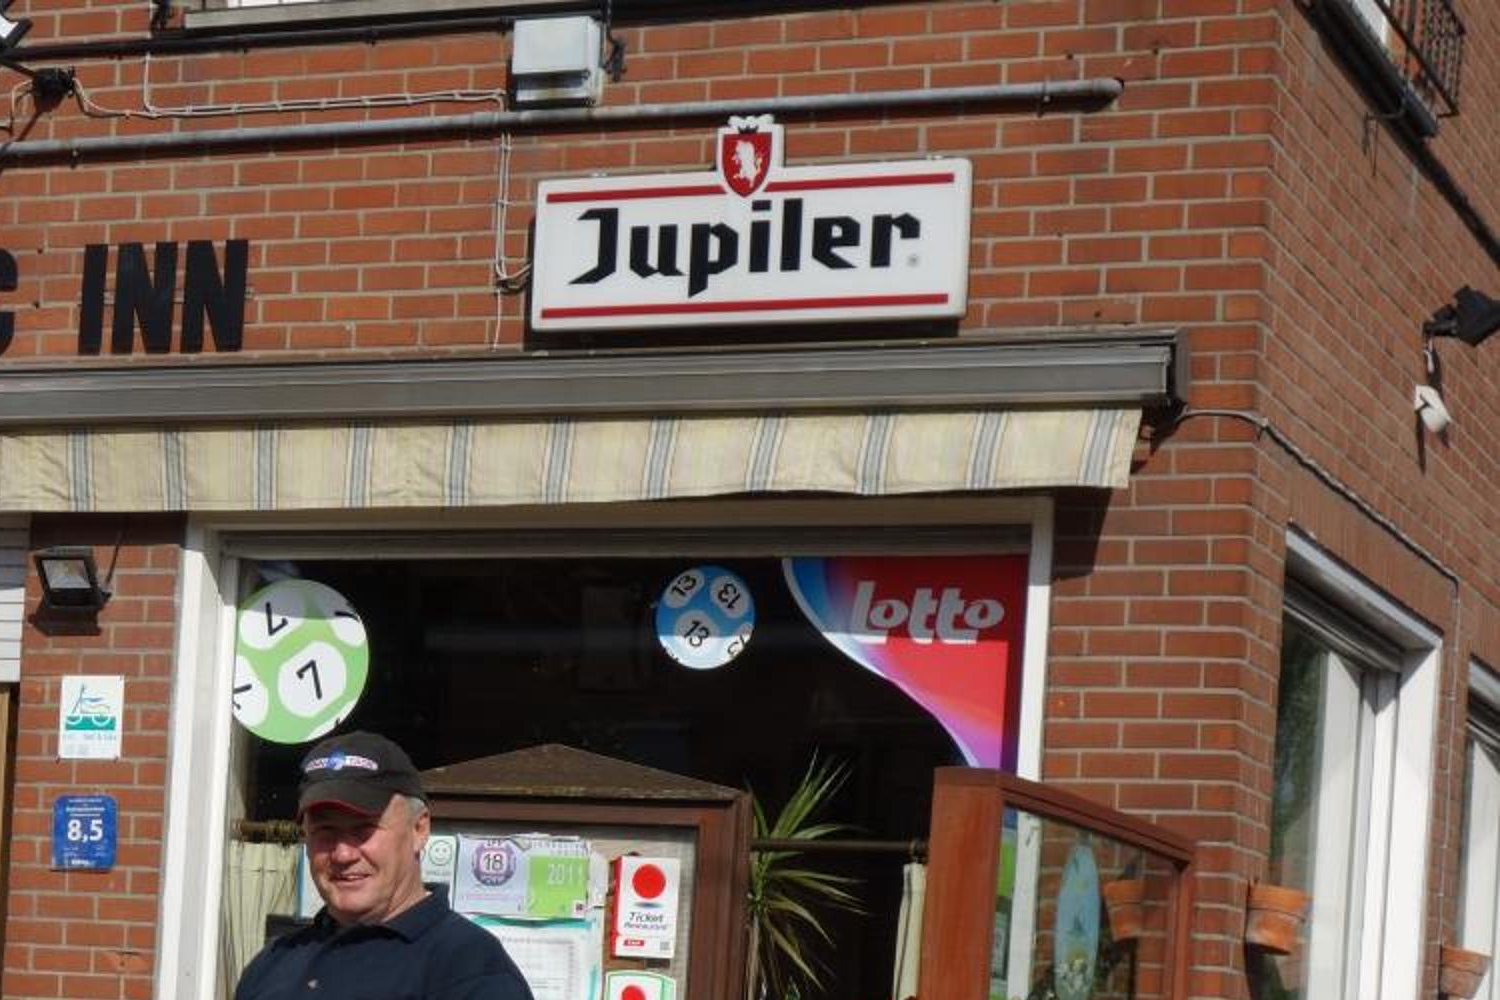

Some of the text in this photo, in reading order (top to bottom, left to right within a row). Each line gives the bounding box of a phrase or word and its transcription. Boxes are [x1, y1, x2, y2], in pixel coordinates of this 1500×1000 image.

[568, 198, 920, 298] Jupiler
[77, 240, 248, 355] INN
[850, 580, 1005, 645] lotto
[296, 659, 323, 700] 7
[67, 819, 103, 843] 8,5
[629, 912, 664, 922] Ticket
